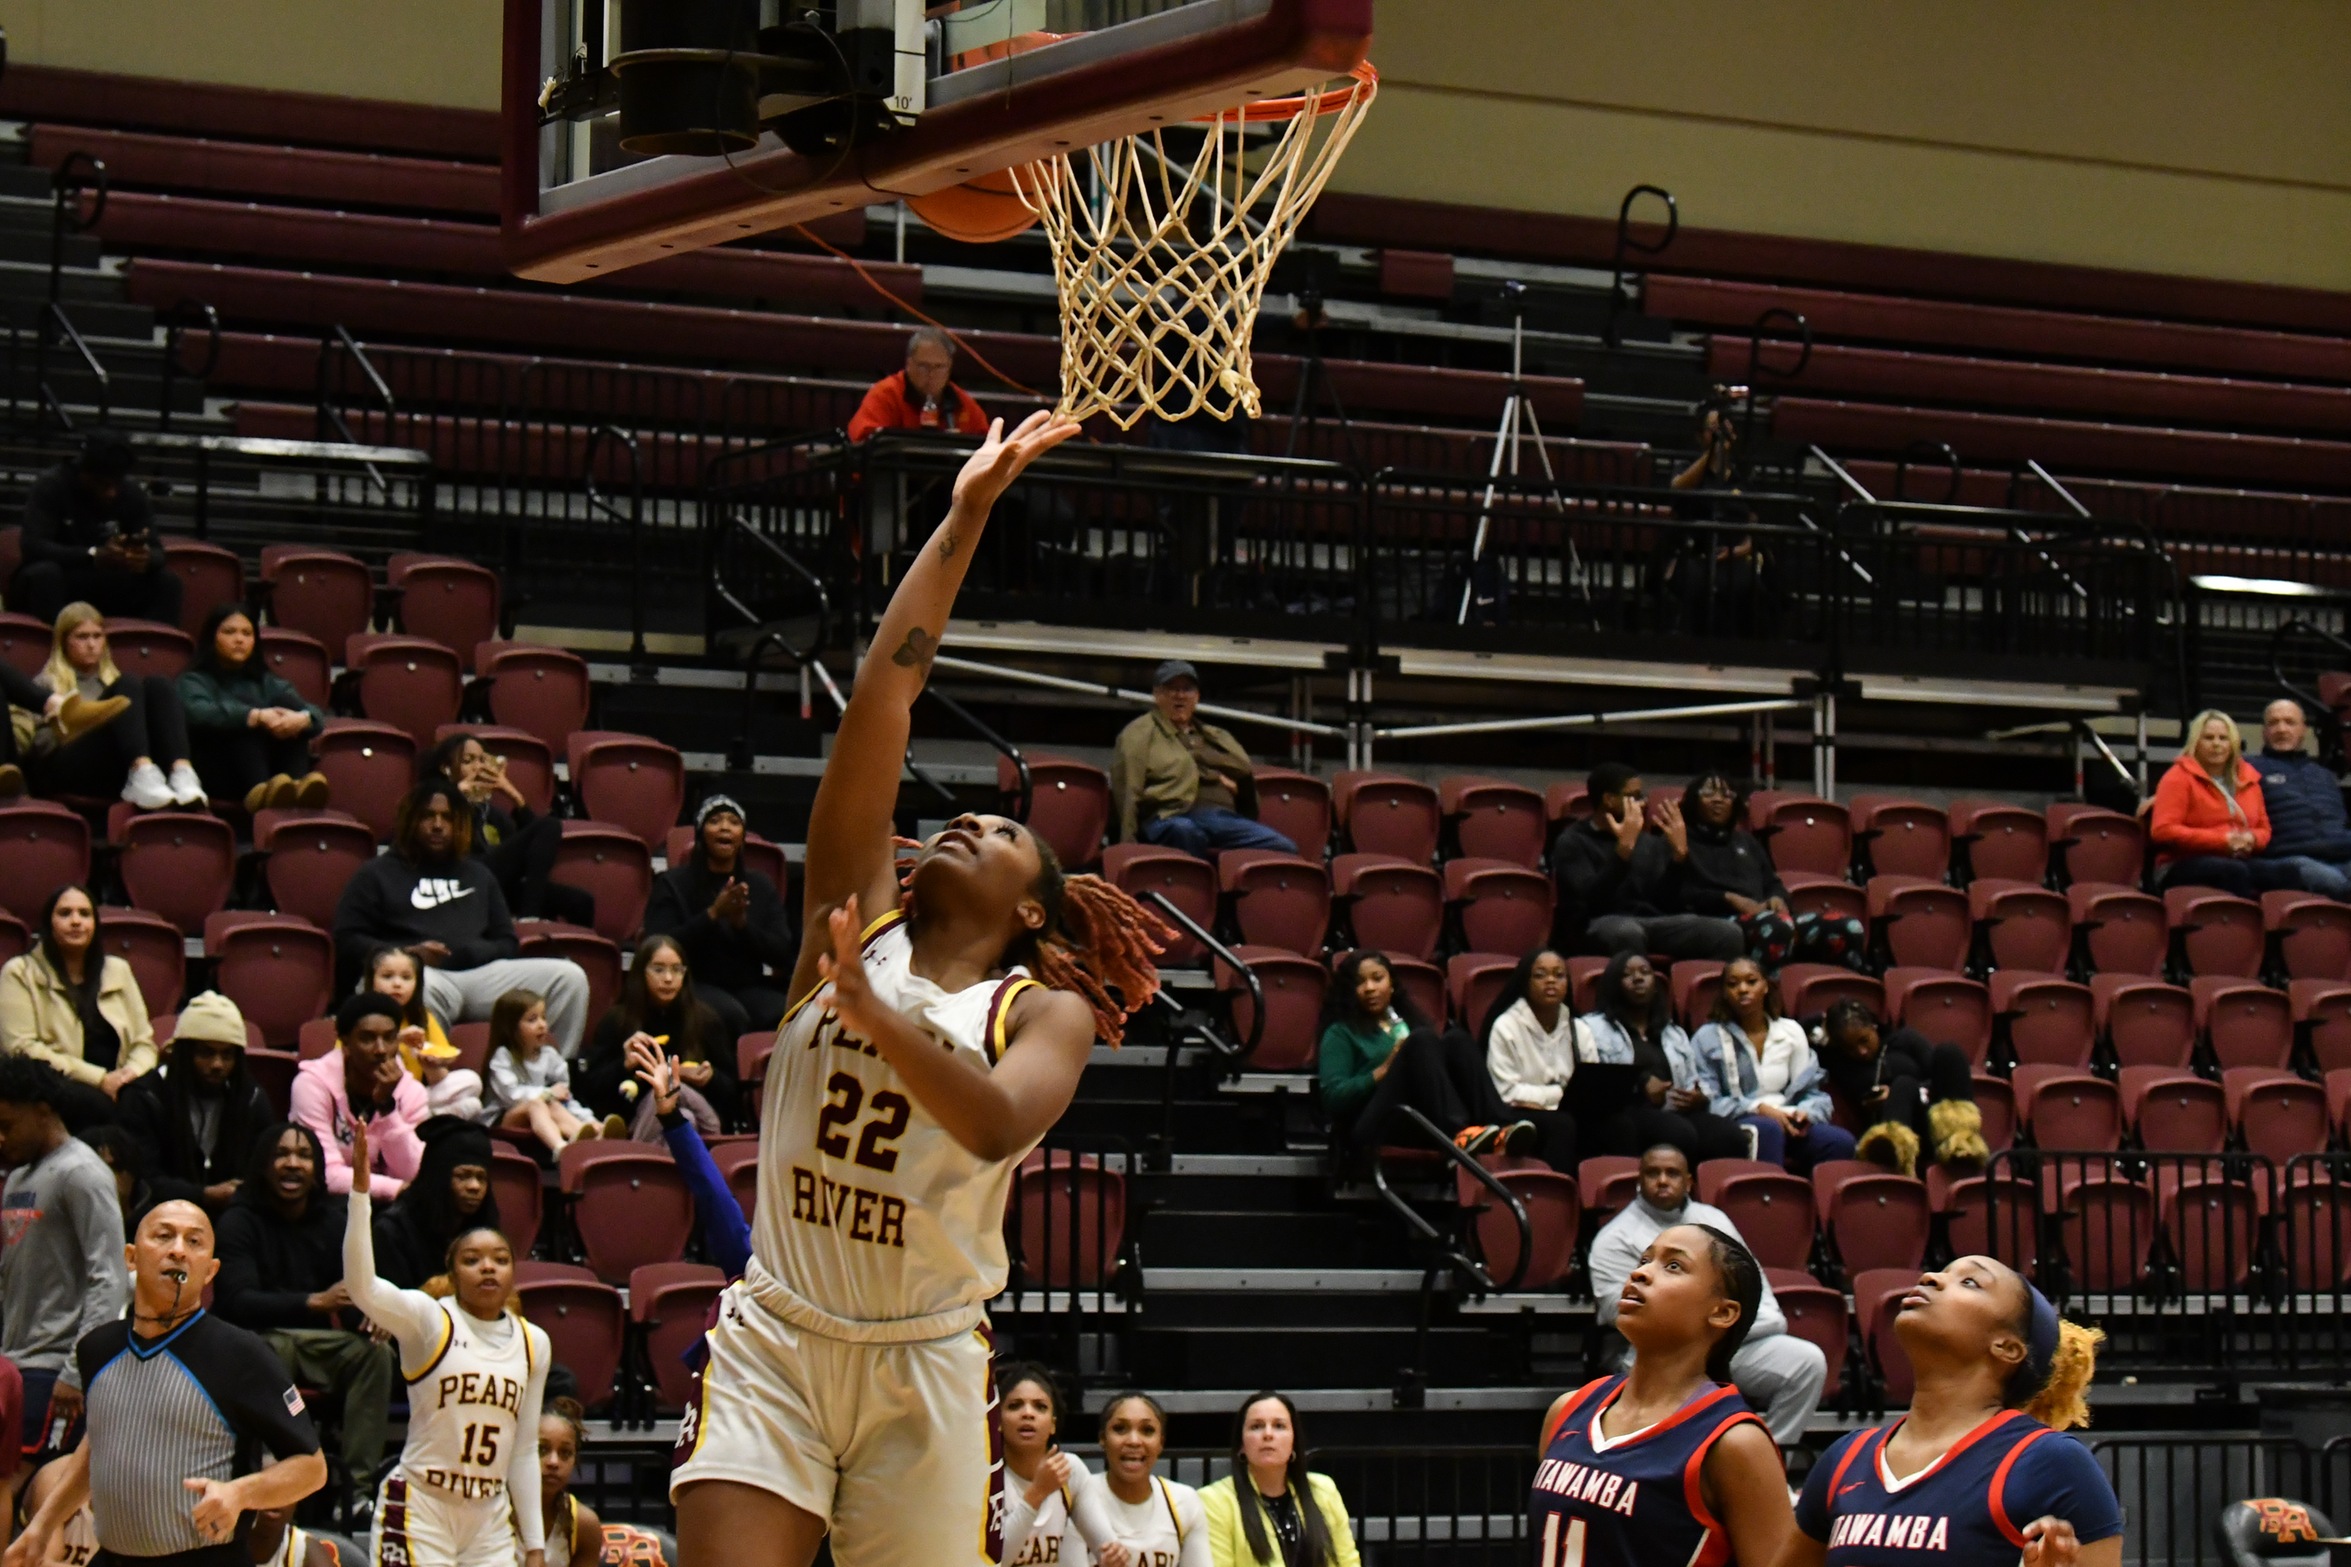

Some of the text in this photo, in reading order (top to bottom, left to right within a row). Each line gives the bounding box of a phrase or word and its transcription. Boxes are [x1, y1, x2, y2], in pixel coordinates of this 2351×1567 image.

[893, 95, 913, 110] 10'
[816, 1070, 912, 1174] 22
[792, 1165, 907, 1248] RIVER
[460, 1422, 501, 1467] 15
[1540, 1511, 1587, 1567] 11
